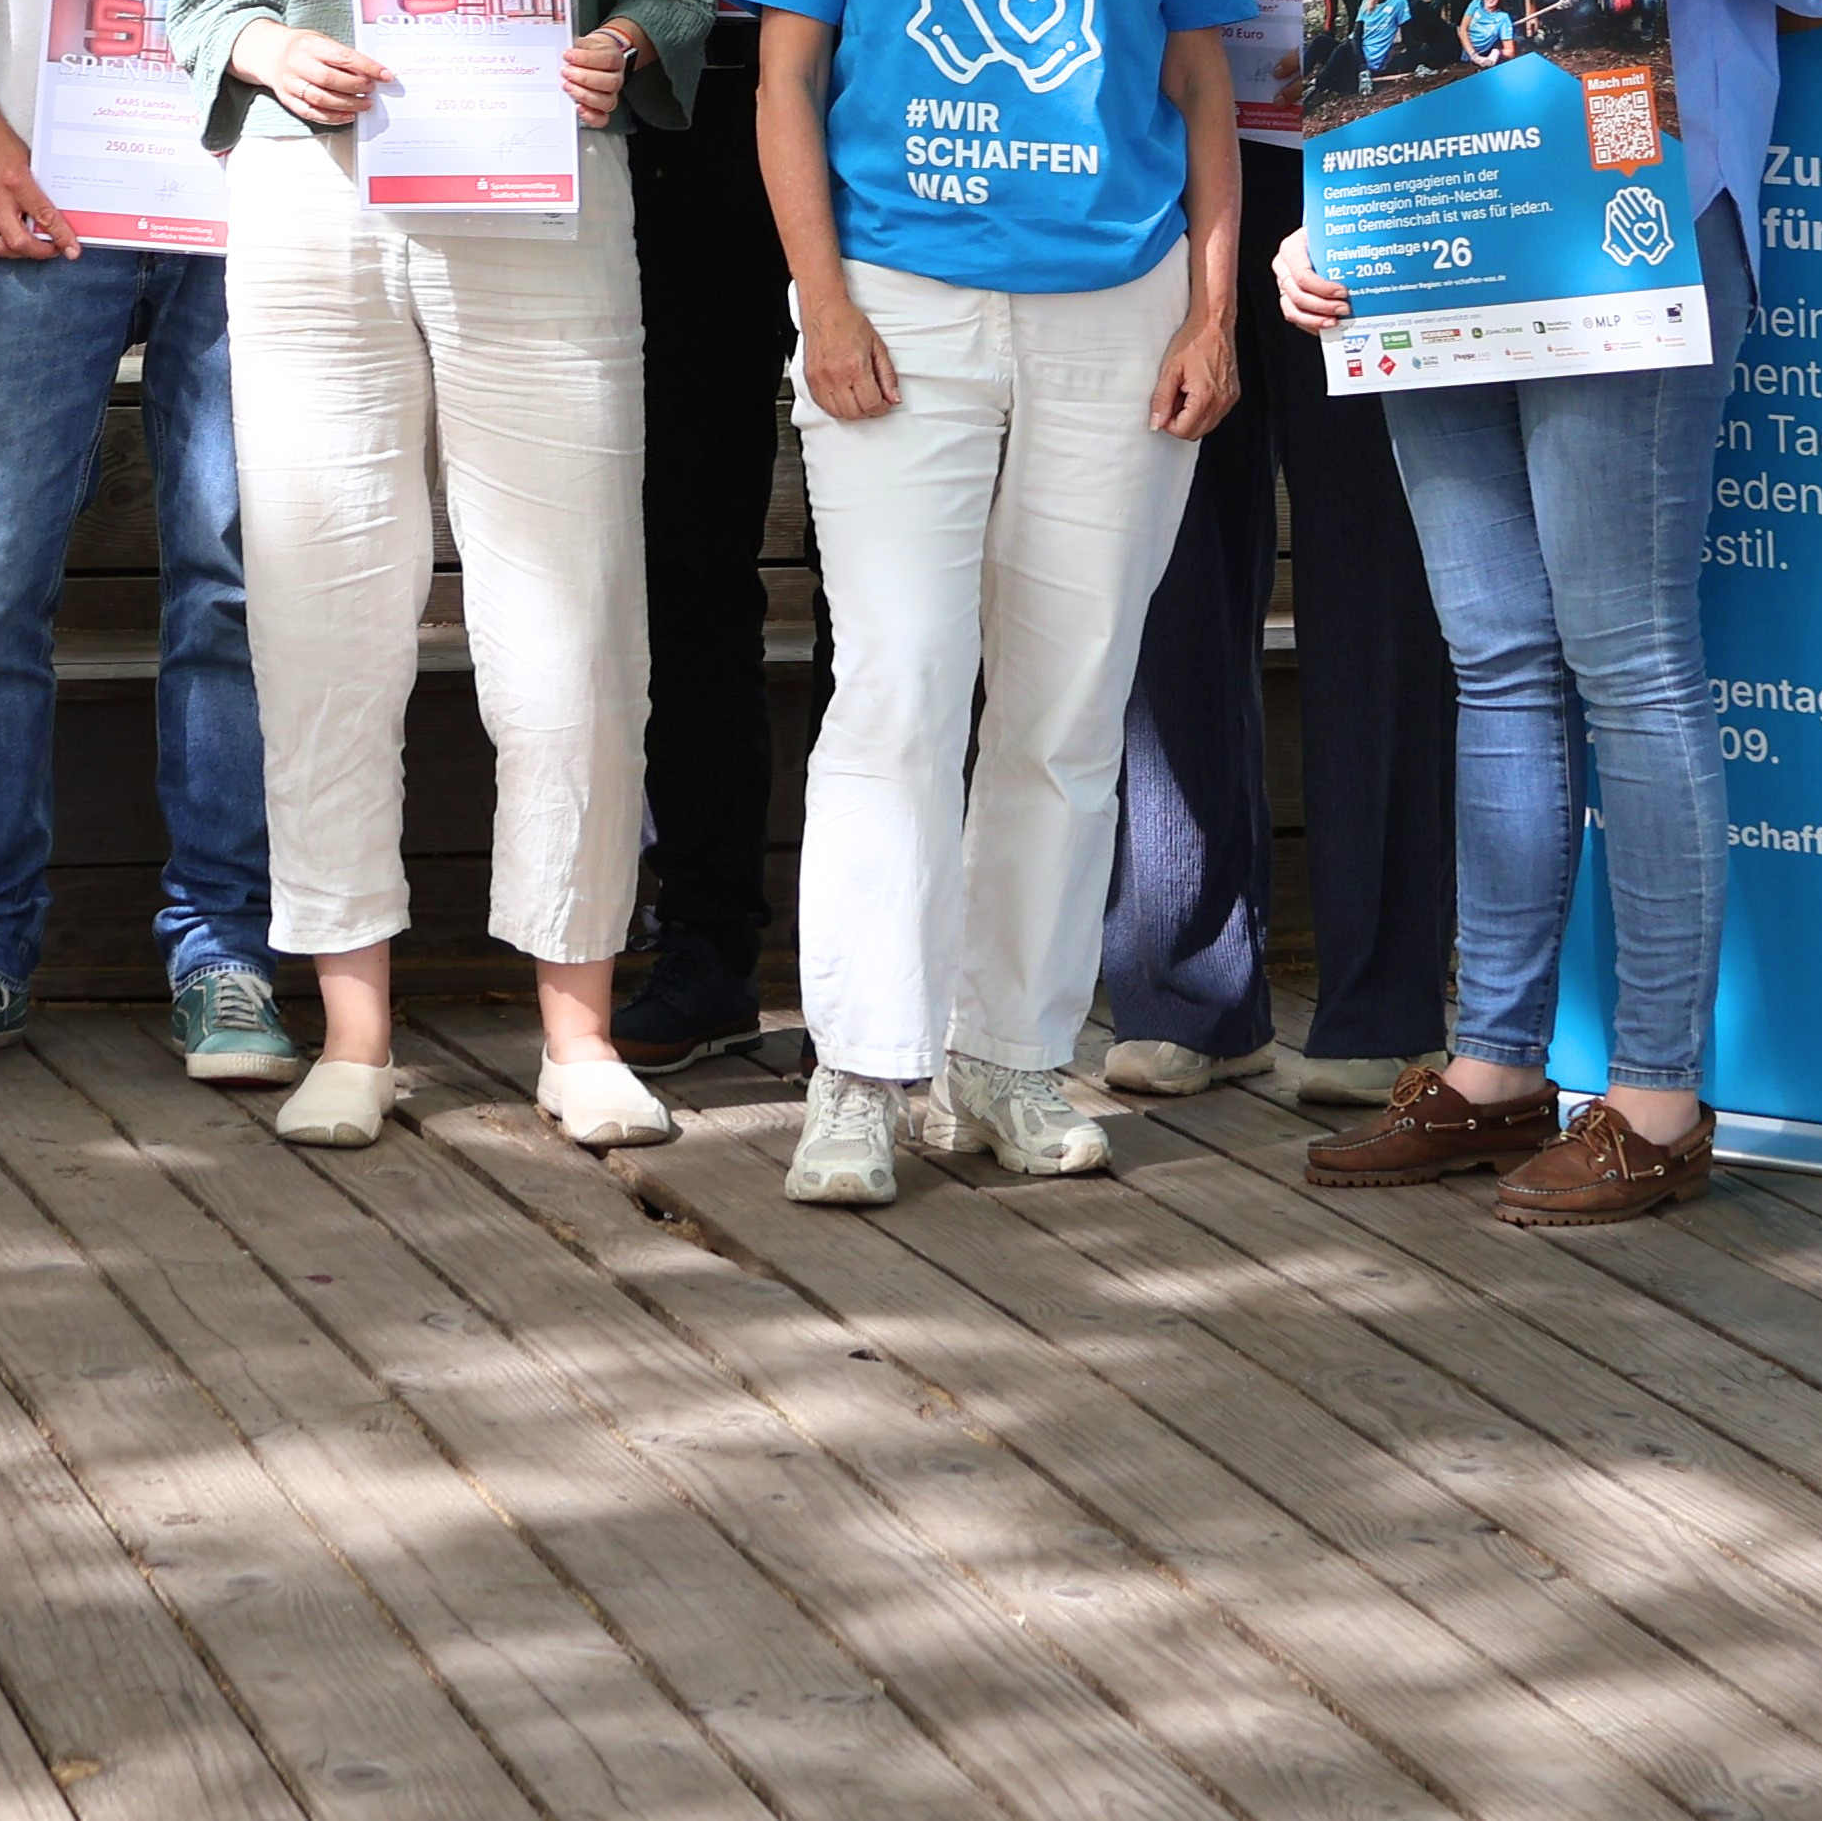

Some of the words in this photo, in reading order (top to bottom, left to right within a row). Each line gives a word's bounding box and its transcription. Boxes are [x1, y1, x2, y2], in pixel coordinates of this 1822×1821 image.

[1236, 28, 1264, 40] Euro
[1587, 76, 1620, 91] Mach
[1621, 73, 1645, 86] mit!
[905, 98, 1000, 133] #WIR
[105, 139, 145, 155] 250,00
[147, 143, 175, 156] Euro
[905, 136, 1099, 175] SCHAFFEN
[1322, 127, 1542, 173] #WIRSCHAFFENWAS
[906, 171, 990, 204] WAS
[1323, 180, 1392, 200] Gemeinsam
[1393, 173, 1461, 194] engagieren
[1463, 170, 1475, 183] in
[1478, 168, 1500, 182] der
[1324, 197, 1412, 218] Metropolregion
[1415, 187, 1503, 208] Rhein-Neckar.
[1325, 222, 1355, 236] Denn
[1358, 213, 1441, 233] Gemeinschaft
[1443, 210, 1458, 223] ist
[1461, 208, 1487, 221] was
[1489, 203, 1507, 218] für
[1510, 200, 1554, 219] jede:n.
[1326, 242, 1421, 262] Freiwilligentage
[1327, 268, 1346, 281] 12.
[1356, 262, 1396, 277] 20.09.
[1595, 314, 1622, 328] MLP
